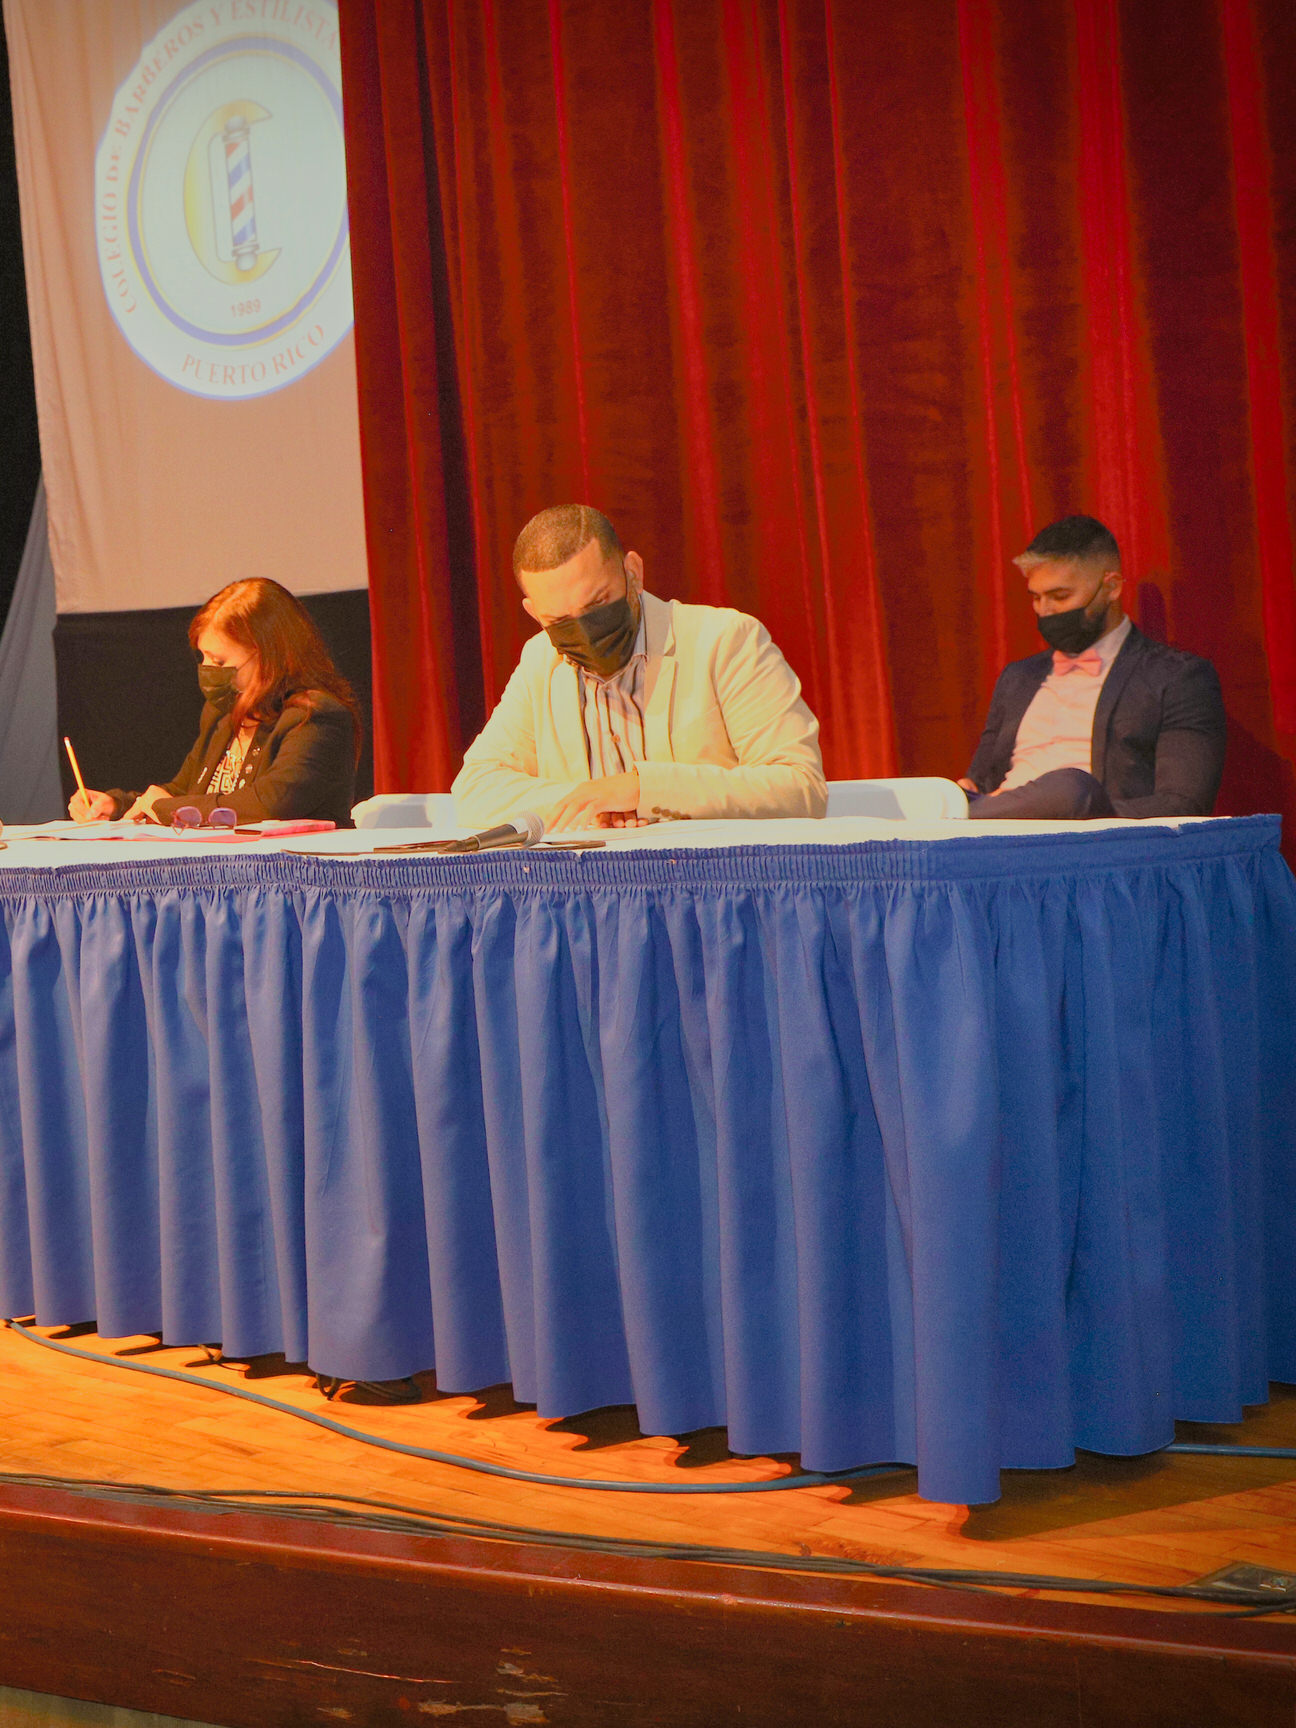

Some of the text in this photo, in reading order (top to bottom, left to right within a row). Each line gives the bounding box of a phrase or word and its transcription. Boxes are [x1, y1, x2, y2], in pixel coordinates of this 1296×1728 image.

[102, 0, 341, 314] COLEGIO DE BARBEROS Y ESTILISTA
[230, 298, 262, 319] 1989
[181, 323, 325, 386] PUERTO RICO
